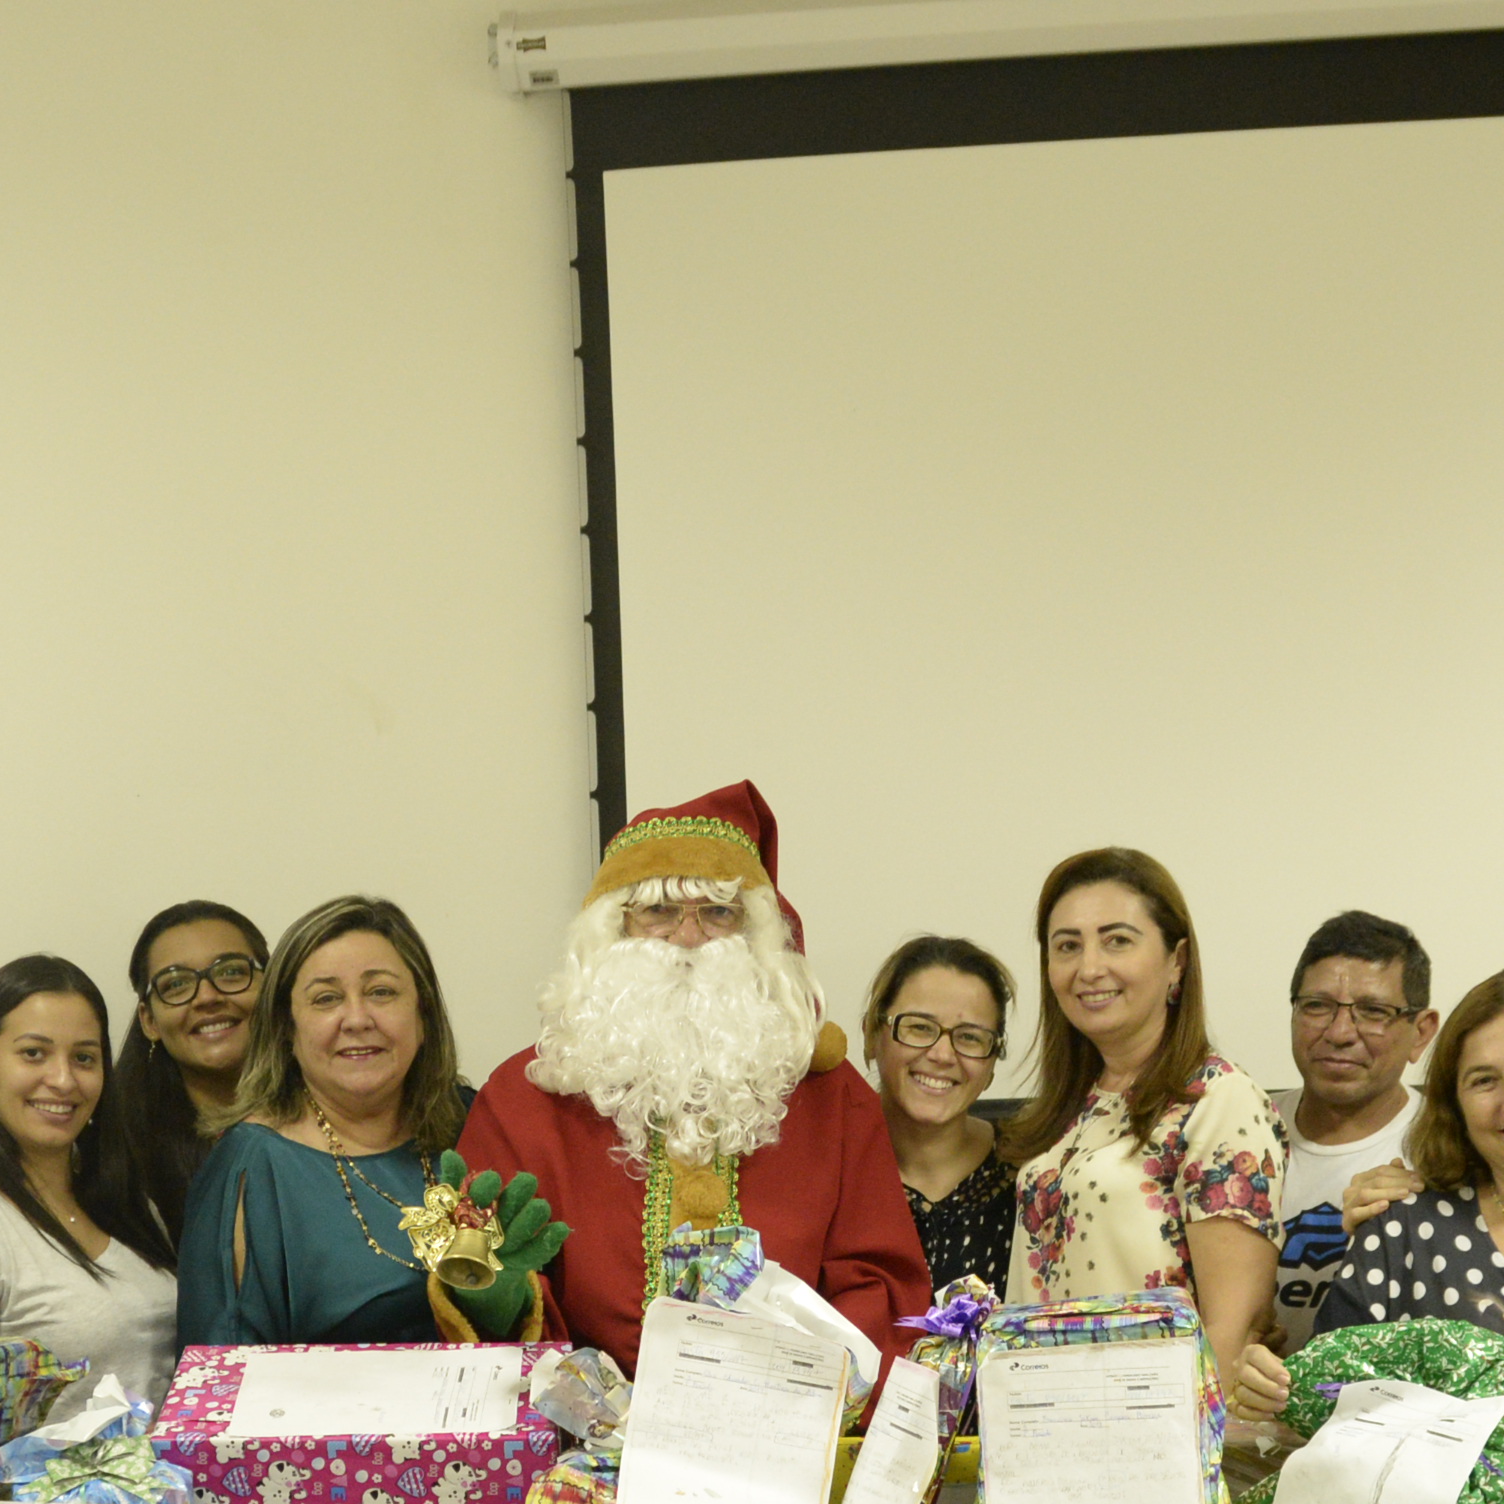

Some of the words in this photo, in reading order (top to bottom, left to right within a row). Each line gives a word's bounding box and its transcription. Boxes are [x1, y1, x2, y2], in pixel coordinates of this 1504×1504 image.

[1275, 1279, 1331, 1309] er
[1020, 1363, 1049, 1371] Correios
[251, 1463, 263, 1477] dog
